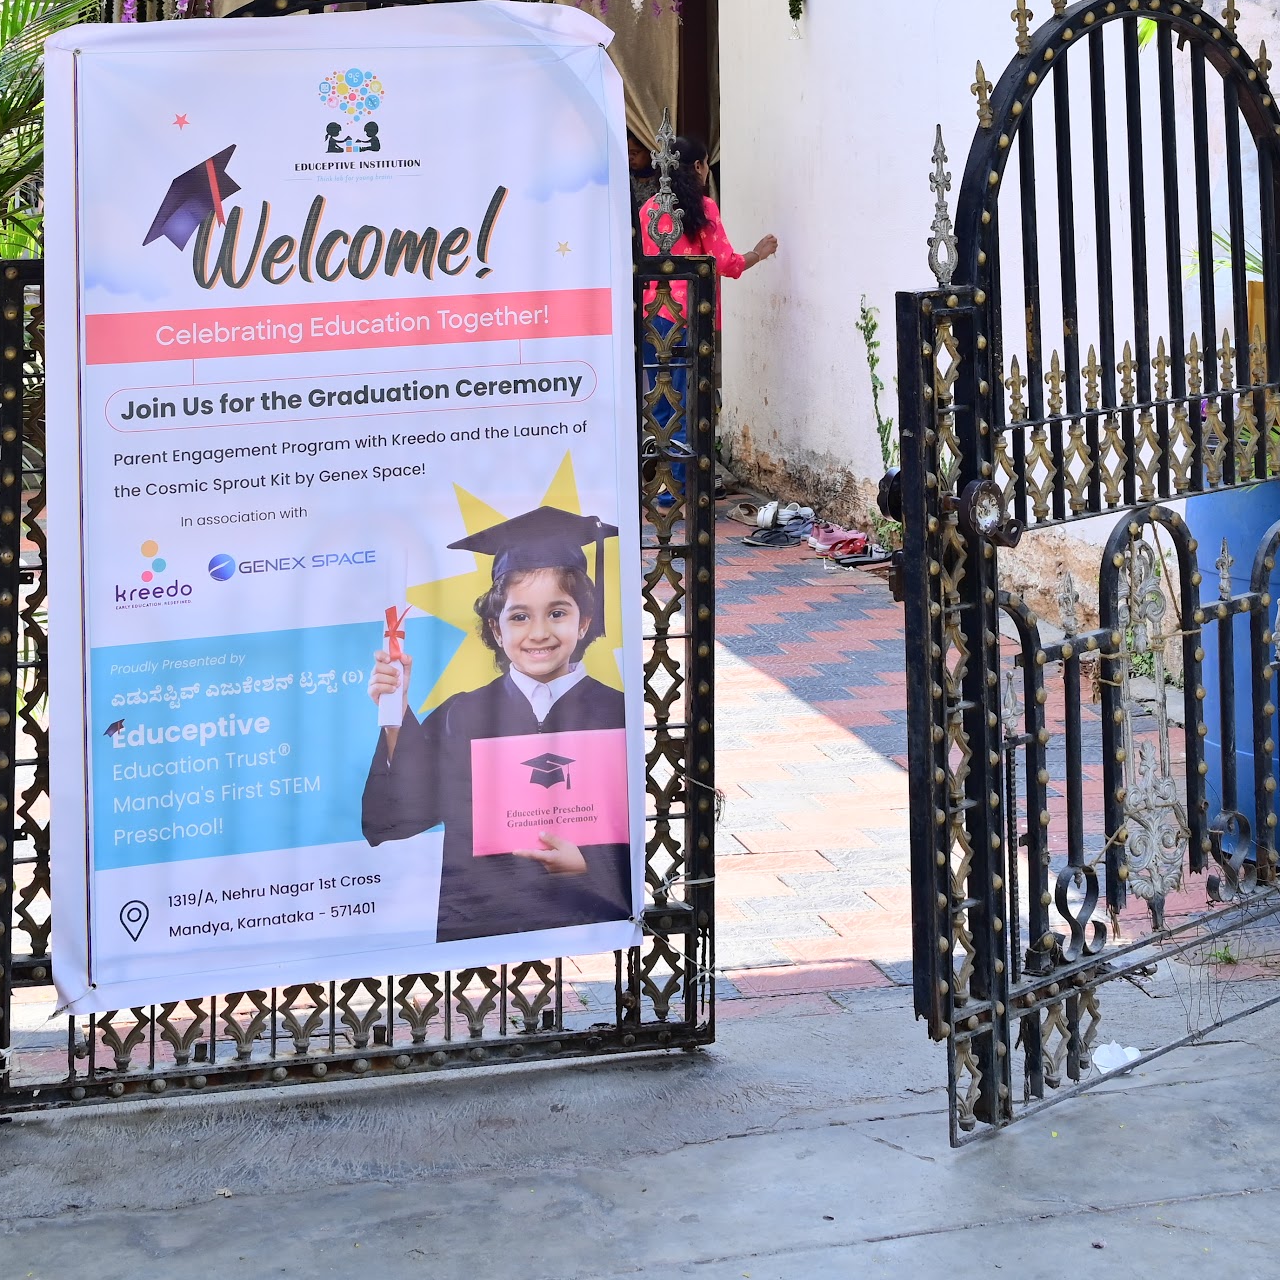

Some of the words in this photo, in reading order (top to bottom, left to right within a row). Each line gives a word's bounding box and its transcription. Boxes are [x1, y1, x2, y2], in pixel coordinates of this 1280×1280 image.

[294, 162, 356, 171] EDUCEPTIVE
[359, 159, 421, 169] INSTITUTION
[192, 186, 508, 290] Welcome!
[156, 317, 303, 347] Celebrating
[311, 310, 430, 338] Education
[437, 305, 549, 334] Together!
[121, 395, 176, 421] Join
[182, 394, 214, 417] Us
[219, 390, 256, 414] for
[260, 387, 302, 411] the
[308, 380, 450, 409] Graduation
[455, 374, 583, 402] Ceremony
[114, 450, 168, 467] Parent
[173, 442, 278, 467] Engagement
[282, 437, 350, 458] Program
[355, 433, 387, 450] with
[392, 429, 446, 447] Kreedo
[451, 426, 480, 442] and
[484, 424, 509, 440] the
[513, 422, 568, 438] Launch
[573, 420, 588, 434] of
[114, 482, 141, 498] the
[145, 476, 209, 496] Cosmic
[213, 472, 266, 494] Sprout
[270, 469, 291, 487] Kit
[295, 468, 316, 490] by
[319, 465, 368, 483] Genex
[373, 462, 426, 484] Space!
[181, 516, 193, 527] In
[197, 509, 276, 526] association
[280, 507, 308, 519] with
[239, 556, 306, 574] GENEX
[312, 550, 376, 567] SPACE
[115, 580, 192, 602] kreedo
[111, 660, 158, 676] Proudly
[162, 654, 227, 670] Presented
[230, 652, 246, 667] by
[112, 714, 270, 749] Educeptive
[113, 751, 219, 781] Education
[113, 785, 216, 816] Mandya's
[221, 779, 264, 802] First
[269, 776, 321, 796] STEM
[553, 804, 594, 814] Preschool
[114, 818, 225, 848] Preschool!
[507, 818, 554, 828] Graduation
[556, 814, 599, 824] Ceremony
[168, 889, 219, 910] 1319/A,
[222, 883, 266, 902] Nehru
[270, 879, 315, 901] Nagar
[319, 877, 337, 893] 1st
[340, 871, 382, 889] Cross
[169, 918, 233, 940] Mandya,
[237, 909, 314, 930] Karnataka
[330, 901, 376, 918] 571401
